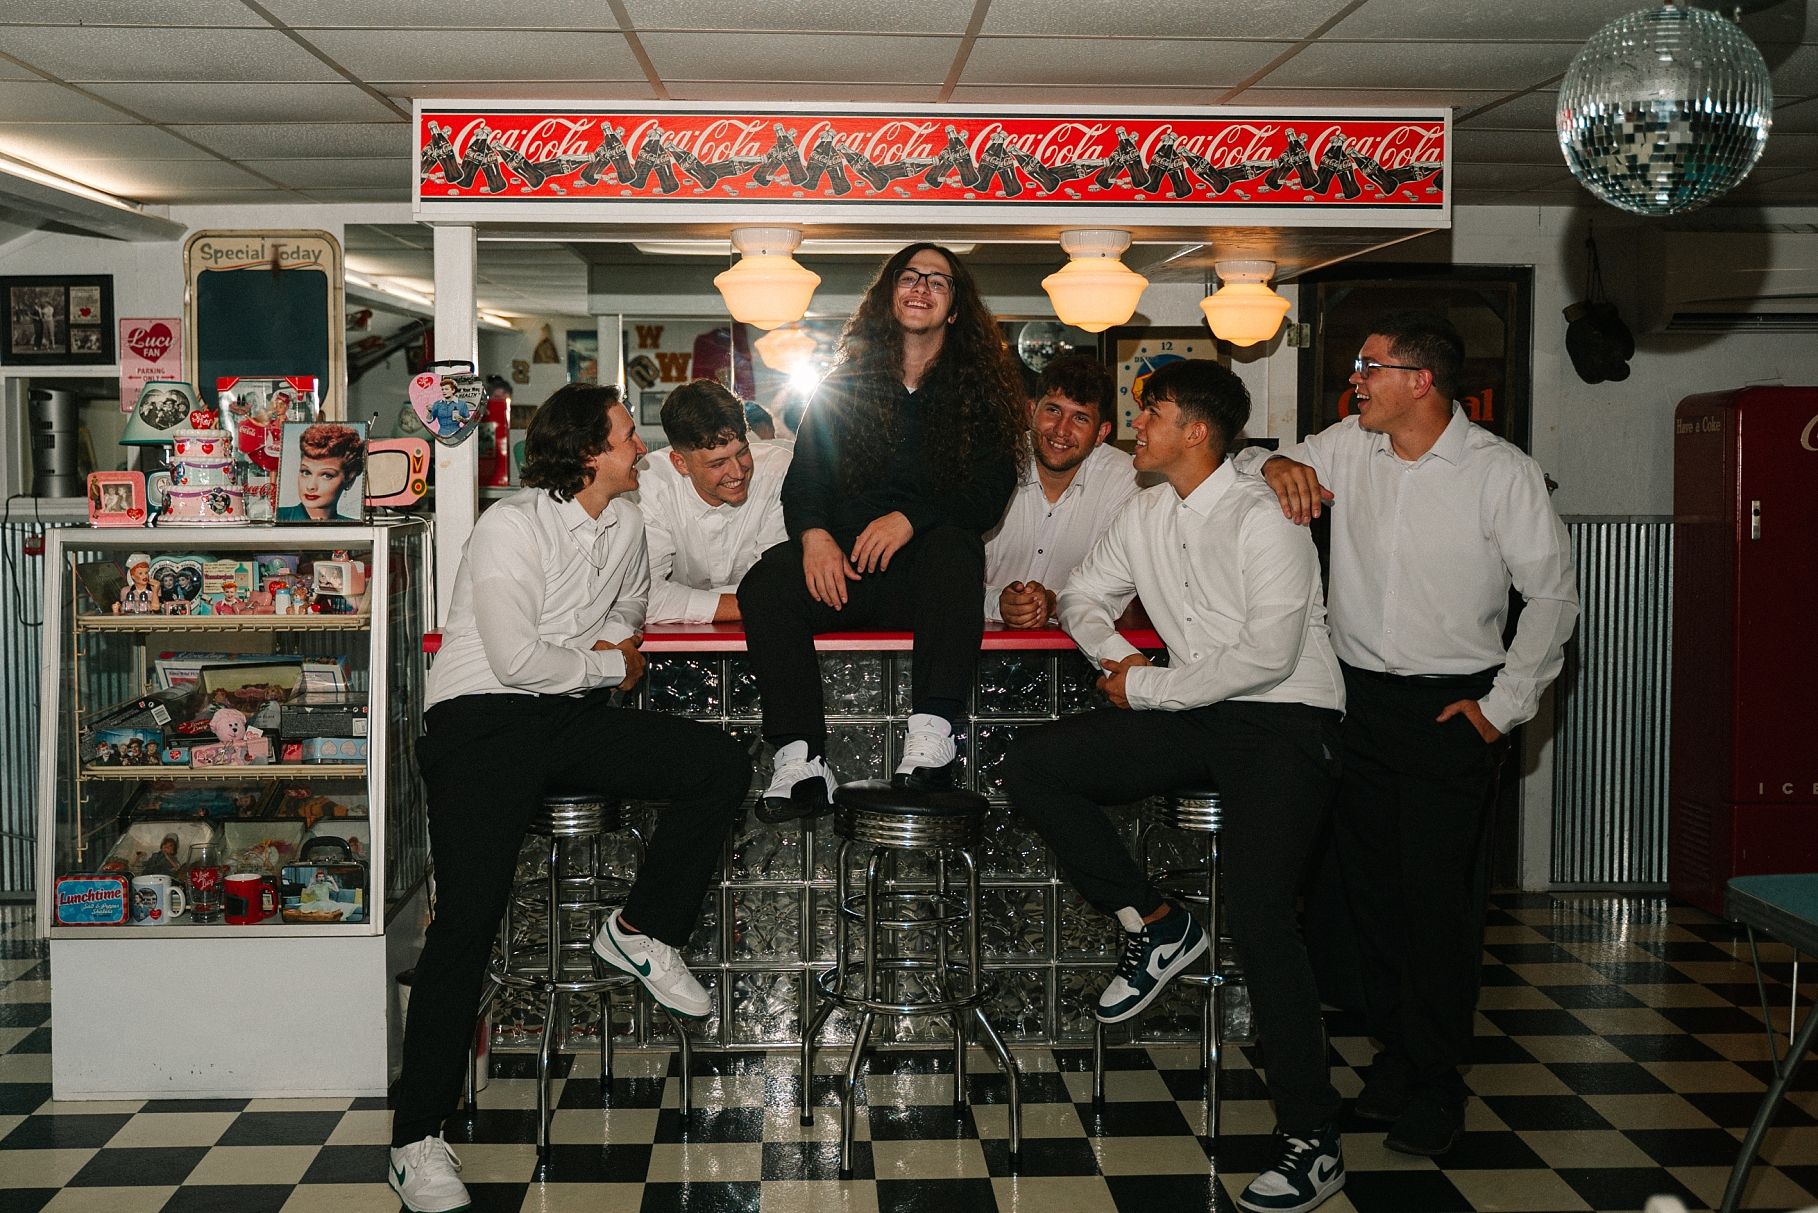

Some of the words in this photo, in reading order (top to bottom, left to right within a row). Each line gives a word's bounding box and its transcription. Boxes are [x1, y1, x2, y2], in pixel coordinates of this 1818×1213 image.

[453, 118, 597, 166] Cca-Cola
[626, 119, 769, 165] Cca-Cola
[799, 120, 941, 166] Cca-Cola
[970, 122, 1112, 169] Cca-Cola
[1140, 124, 1281, 171] Cca-Cola
[1310, 125, 1444, 171] Cca-Cola
[200, 242, 265, 264] Special
[271, 243, 323, 263] Today
[127, 328, 175, 350] Lucy
[1161, 341, 1174, 351] 12
[143, 348, 161, 357] FAN
[1120, 386, 1128, 396] 9
[1676, 418, 1694, 434] Have
[1695, 422, 1701, 432] a
[1702, 415, 1721, 432] Coke
[59, 887, 122, 905] Lunchtime
